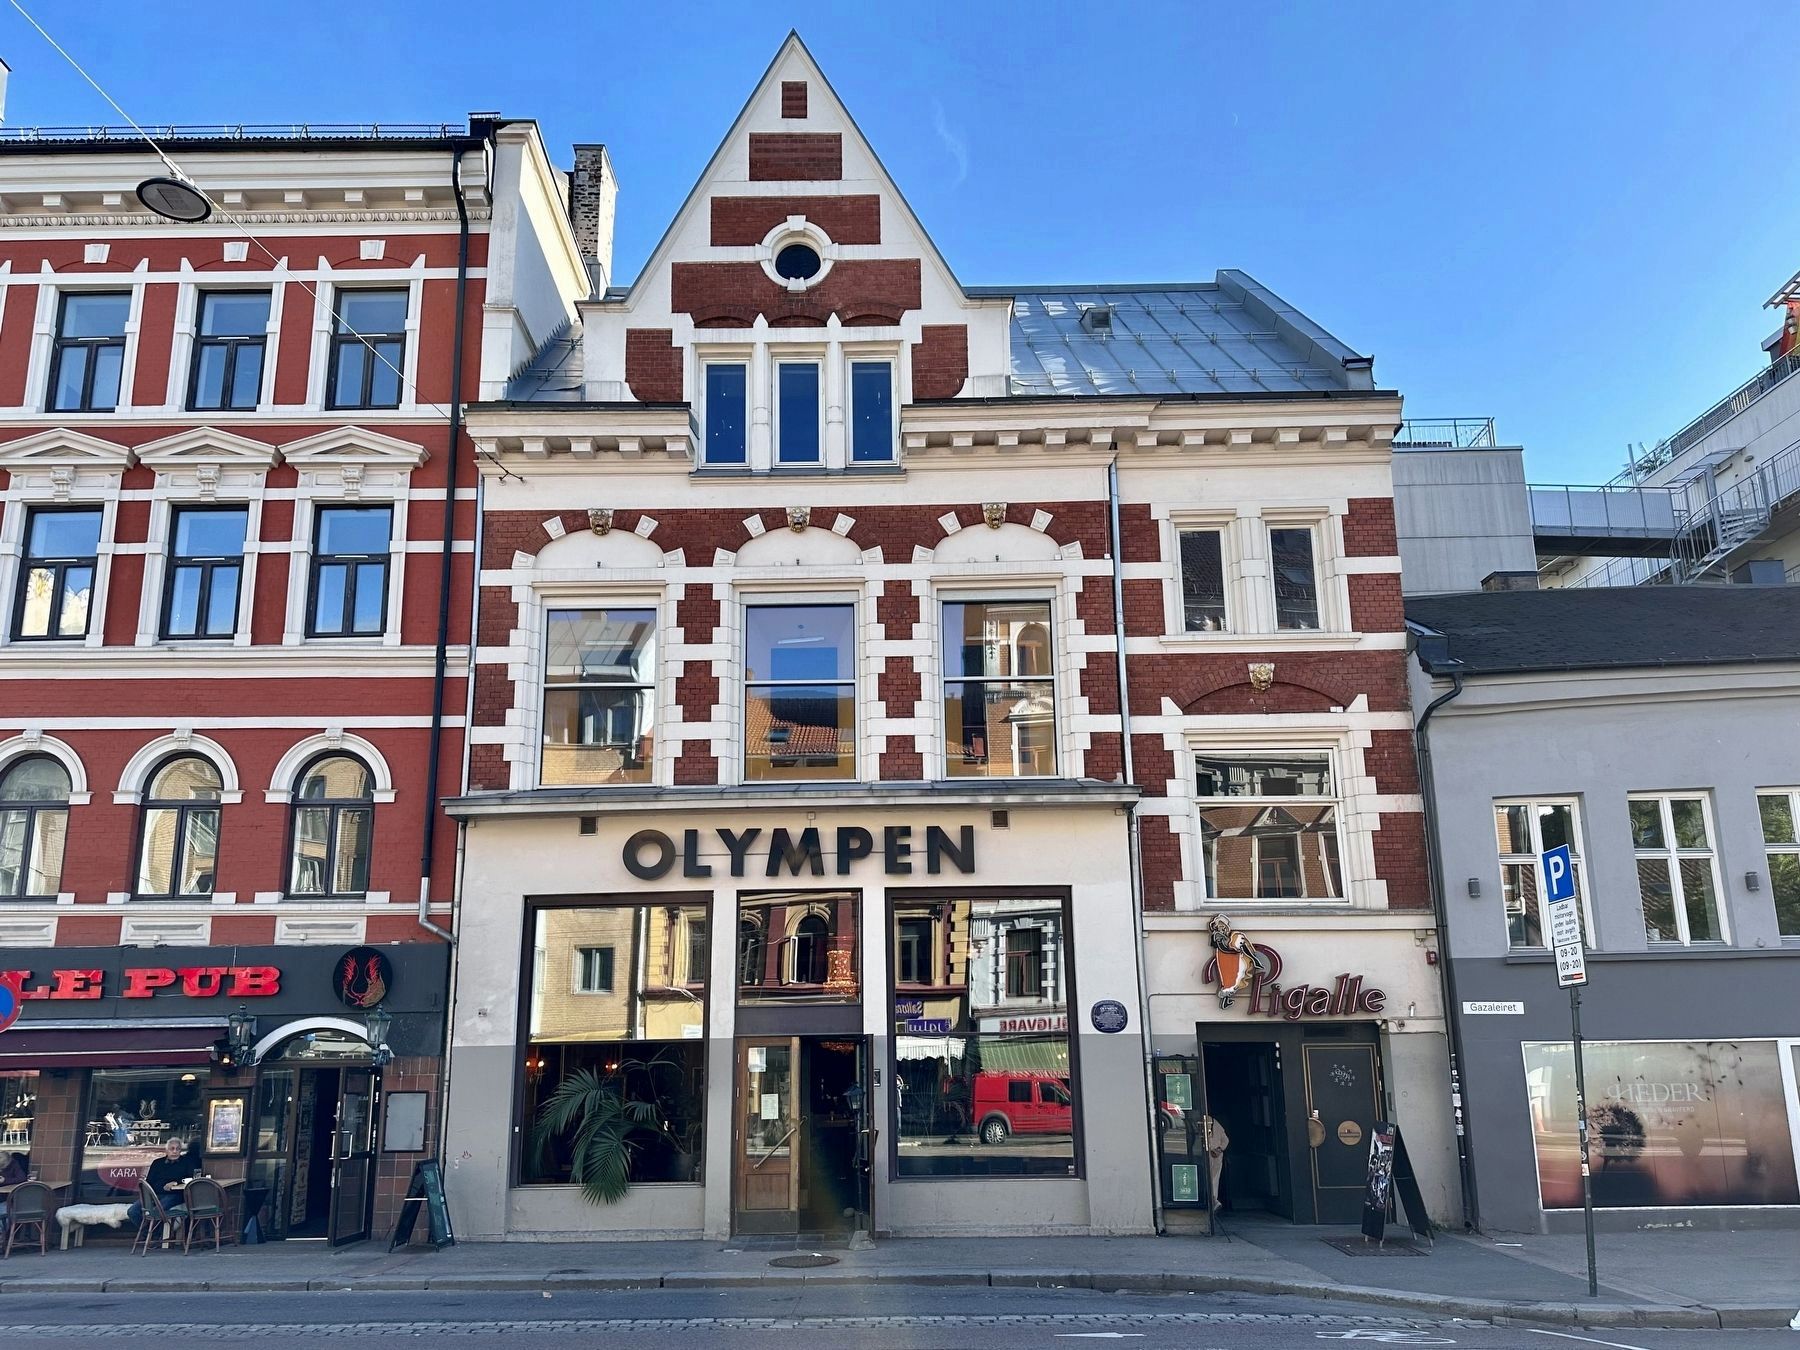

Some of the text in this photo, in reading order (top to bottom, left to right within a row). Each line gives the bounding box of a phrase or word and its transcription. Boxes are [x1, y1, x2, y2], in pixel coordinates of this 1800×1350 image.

[622, 825, 975, 880] OLYMPEN
[1548, 855, 1565, 895] P
[1560, 946, 1578, 958] 09-20
[1560, 958, 1581, 972] (09-20)
[123, 966, 282, 998] PUB
[1201, 943, 1387, 1020] Pigalle
[1470, 1002, 1517, 1012] Gazaleiret
[1607, 1082, 1708, 1103] HEDER
